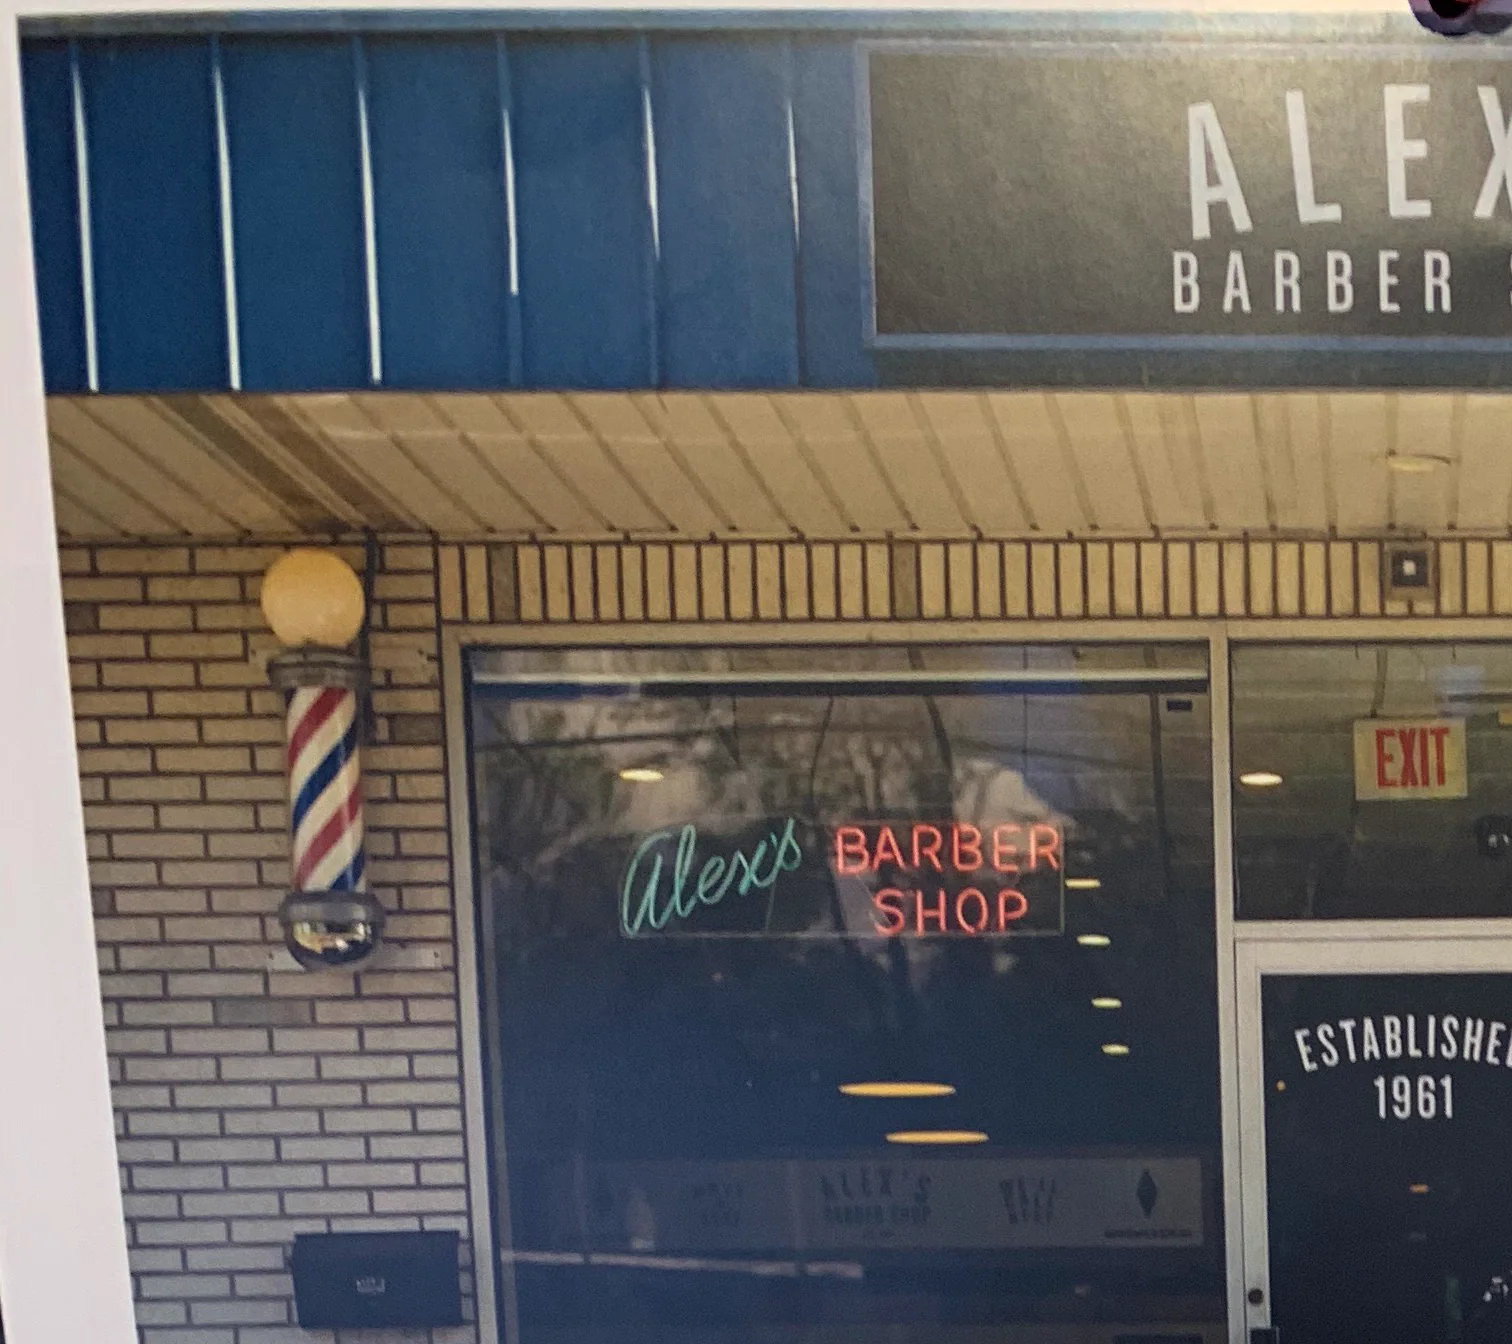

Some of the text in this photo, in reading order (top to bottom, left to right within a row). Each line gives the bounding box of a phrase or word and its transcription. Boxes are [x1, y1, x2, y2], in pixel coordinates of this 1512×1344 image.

[1172, 247, 1453, 315] BARBER
[1375, 726, 1449, 788] EXIT
[622, 816, 802, 939] Alex's
[834, 824, 1061, 875] BARBER
[872, 887, 1029, 937] SHOP
[1374, 1075, 1454, 1119] 1961
